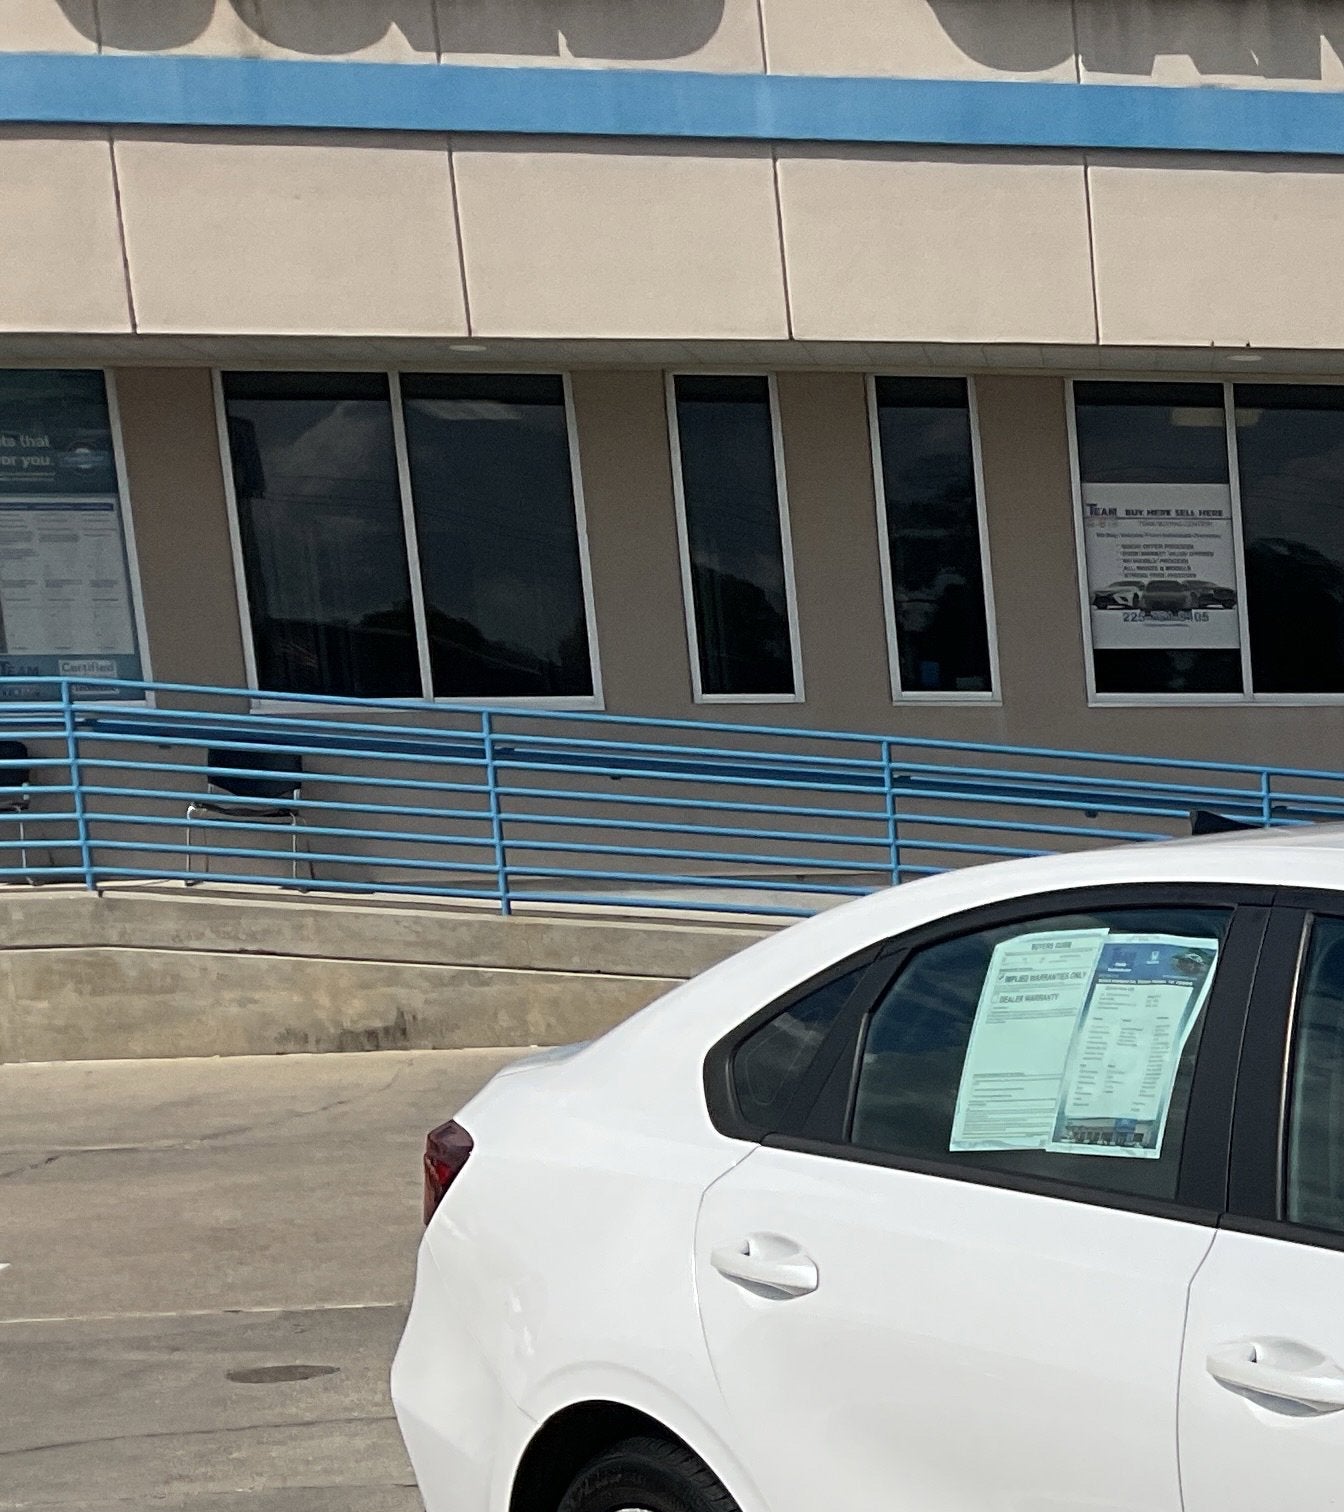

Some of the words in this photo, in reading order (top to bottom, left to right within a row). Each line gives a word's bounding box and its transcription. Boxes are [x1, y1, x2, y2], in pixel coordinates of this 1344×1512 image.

[20, 433, 50, 448] that
[21, 455, 51, 469] you
[1125, 508, 1143, 517] BUY
[1147, 508, 1172, 517] HERE
[1175, 509, 1195, 517] SELL
[1199, 509, 1223, 517] HERE
[61, 661, 115, 674] Certified
[1070, 971, 1087, 980] ONLY
[1000, 995, 1024, 1004] DEALER
[1025, 993, 1060, 1001] WARRANTY
